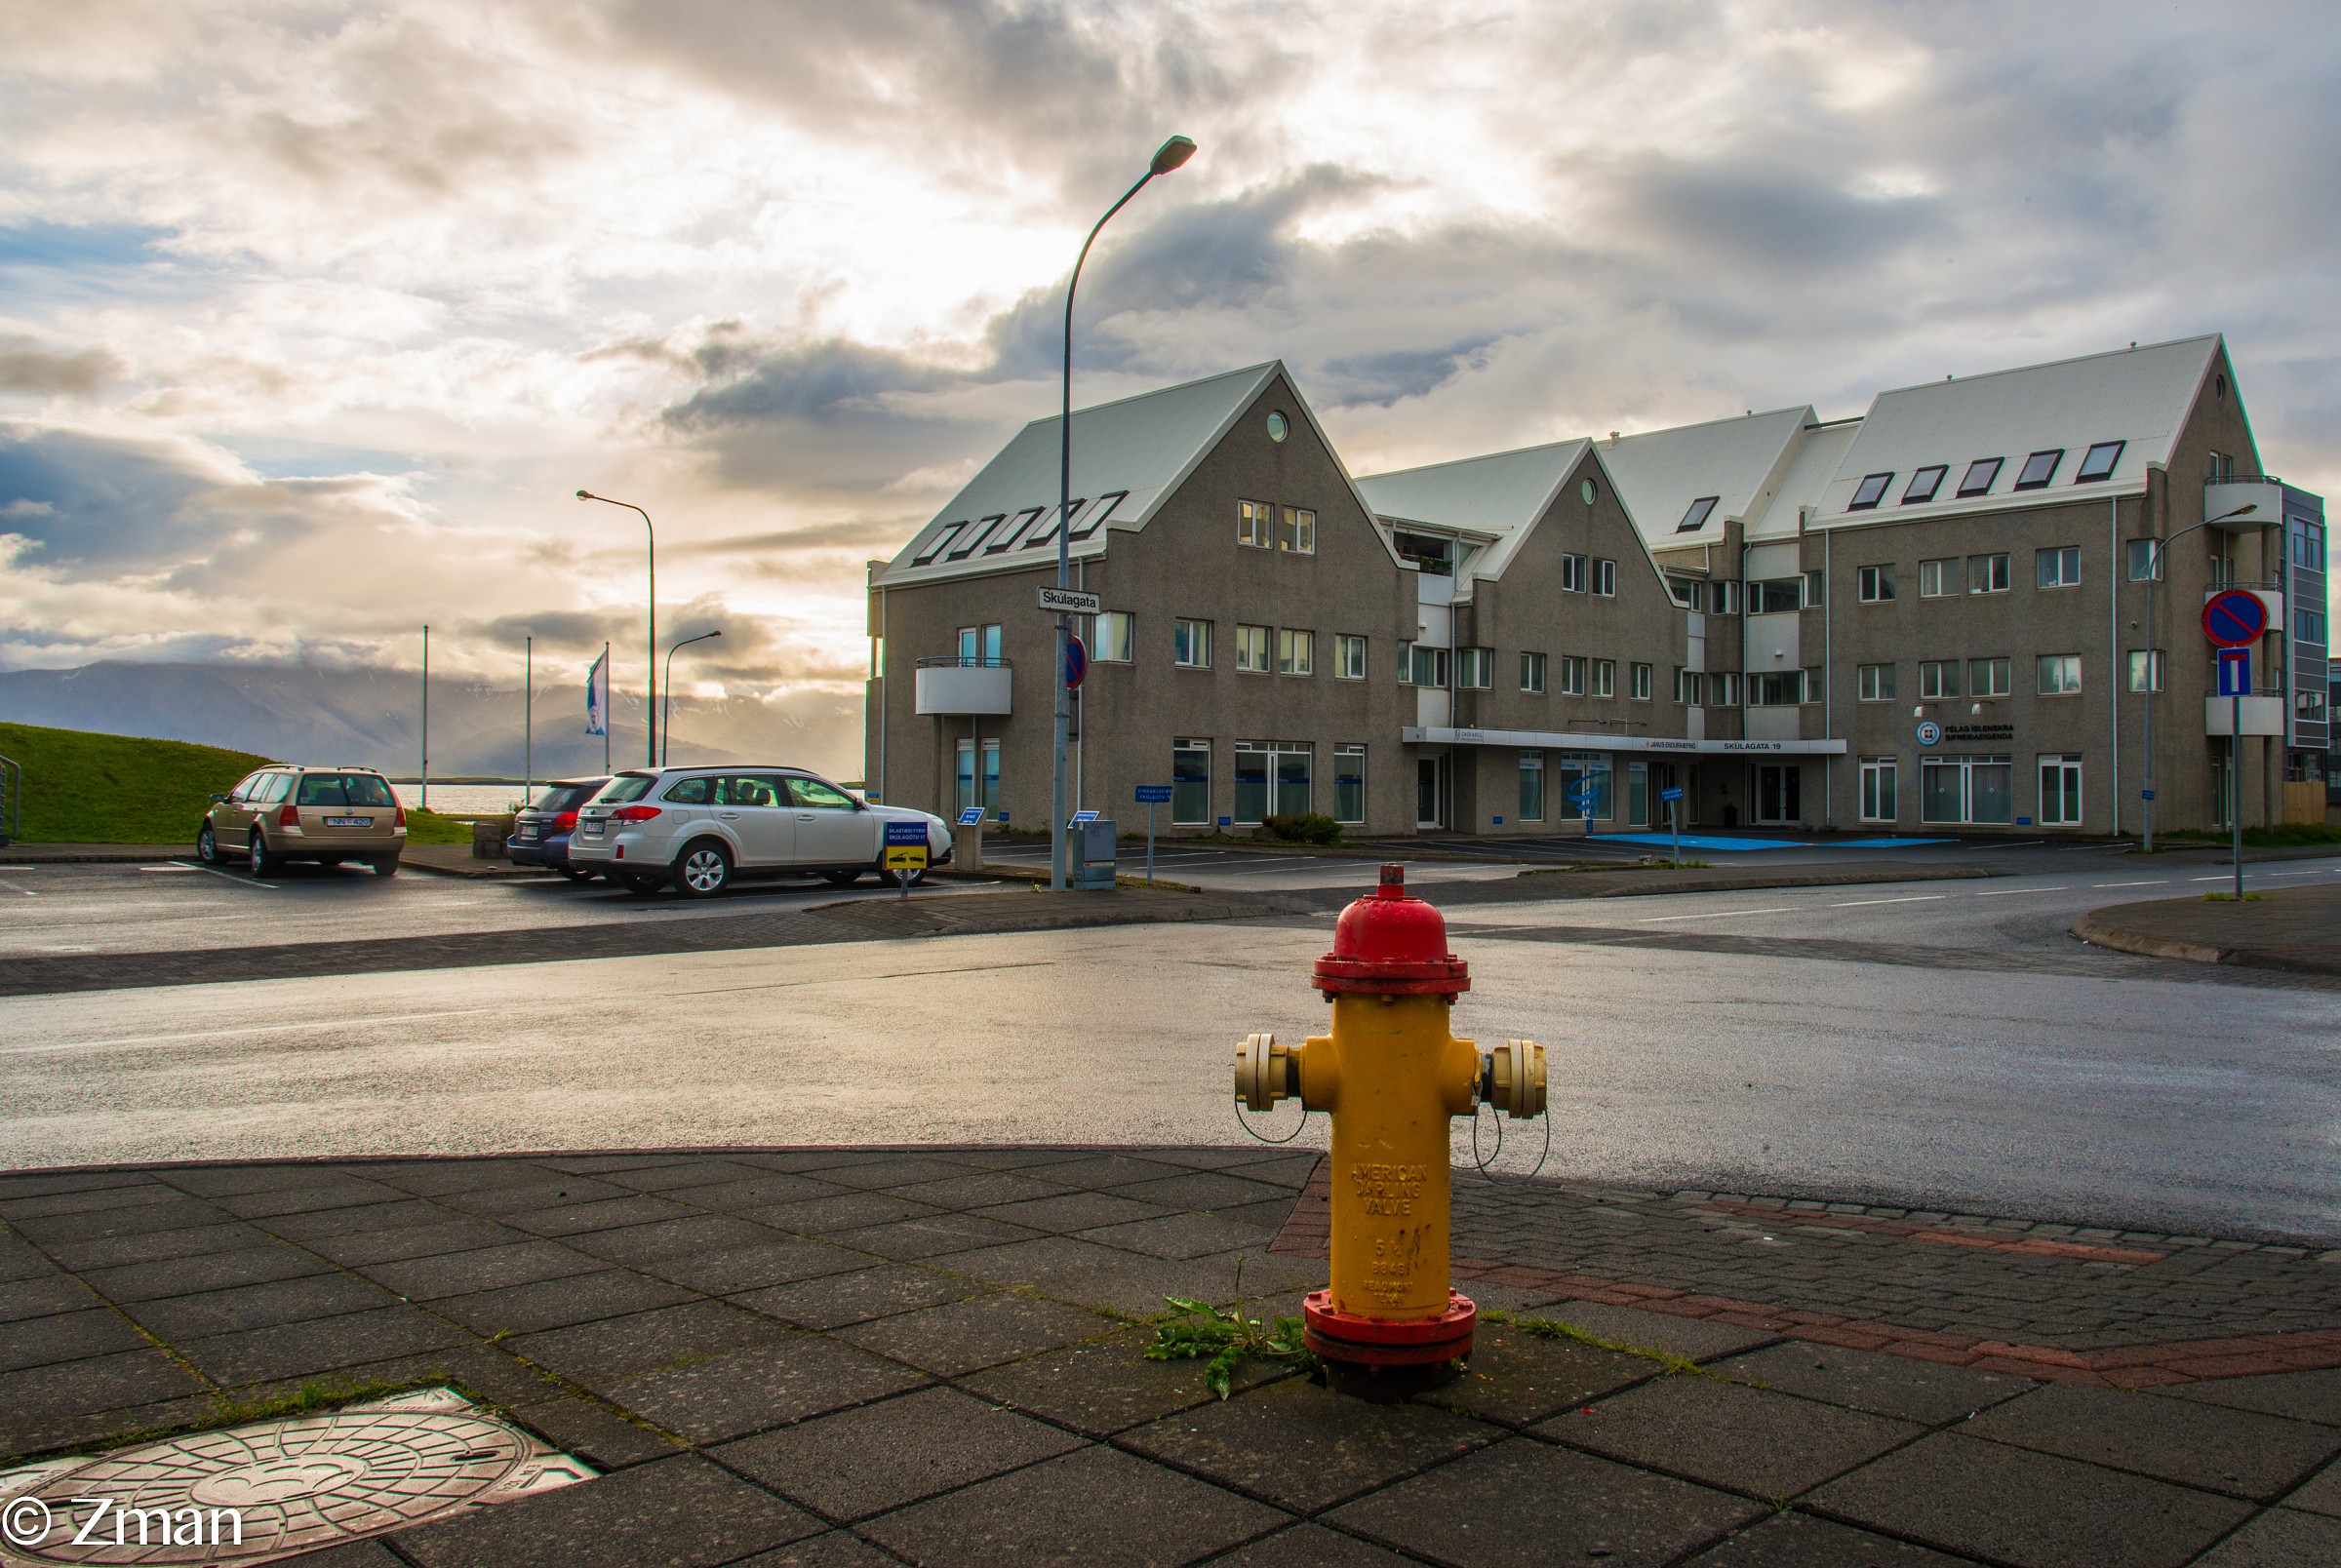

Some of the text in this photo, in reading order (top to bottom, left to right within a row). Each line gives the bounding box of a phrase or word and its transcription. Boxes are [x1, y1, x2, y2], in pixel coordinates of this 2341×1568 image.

[1043, 591, 1096, 608] Skúlagata
[1351, 1163, 1428, 1182] AMERICAN
[1355, 1180, 1421, 1199] DARLING
[1364, 1197, 1411, 1216] VALVE
[1362, 1279, 1413, 1293] BEAUMONT
